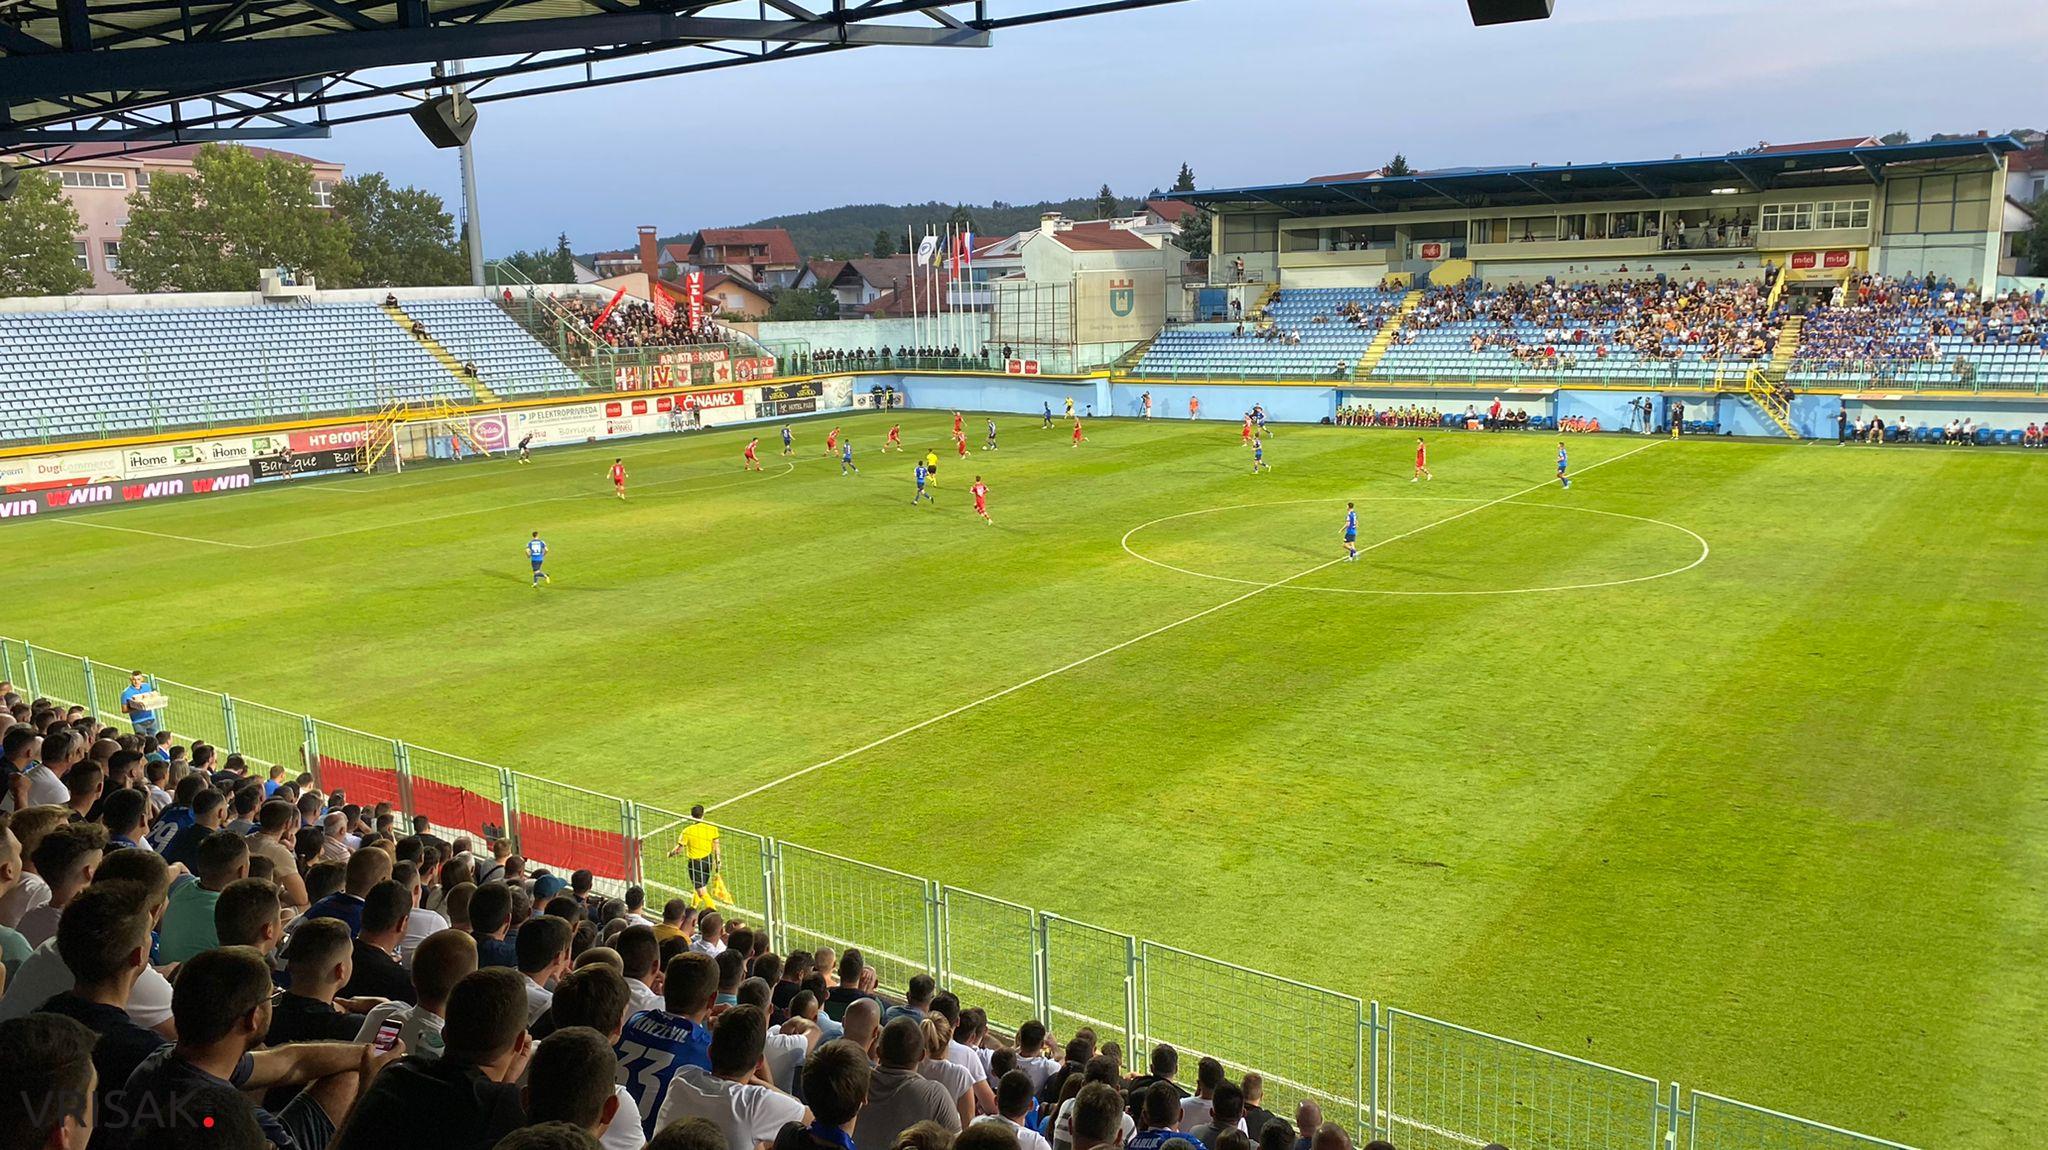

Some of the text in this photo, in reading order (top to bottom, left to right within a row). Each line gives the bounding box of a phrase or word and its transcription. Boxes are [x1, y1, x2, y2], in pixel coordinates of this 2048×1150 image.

[698, 392, 736, 409] NAMEX
[537, 405, 598, 420] ELEKTROPRIVREDA
[308, 434, 328, 447] HT
[211, 446, 247, 459] iHome
[130, 455, 168, 468] iHome
[259, 455, 318, 473] Barque
[615, 1040, 676, 1121] 33
